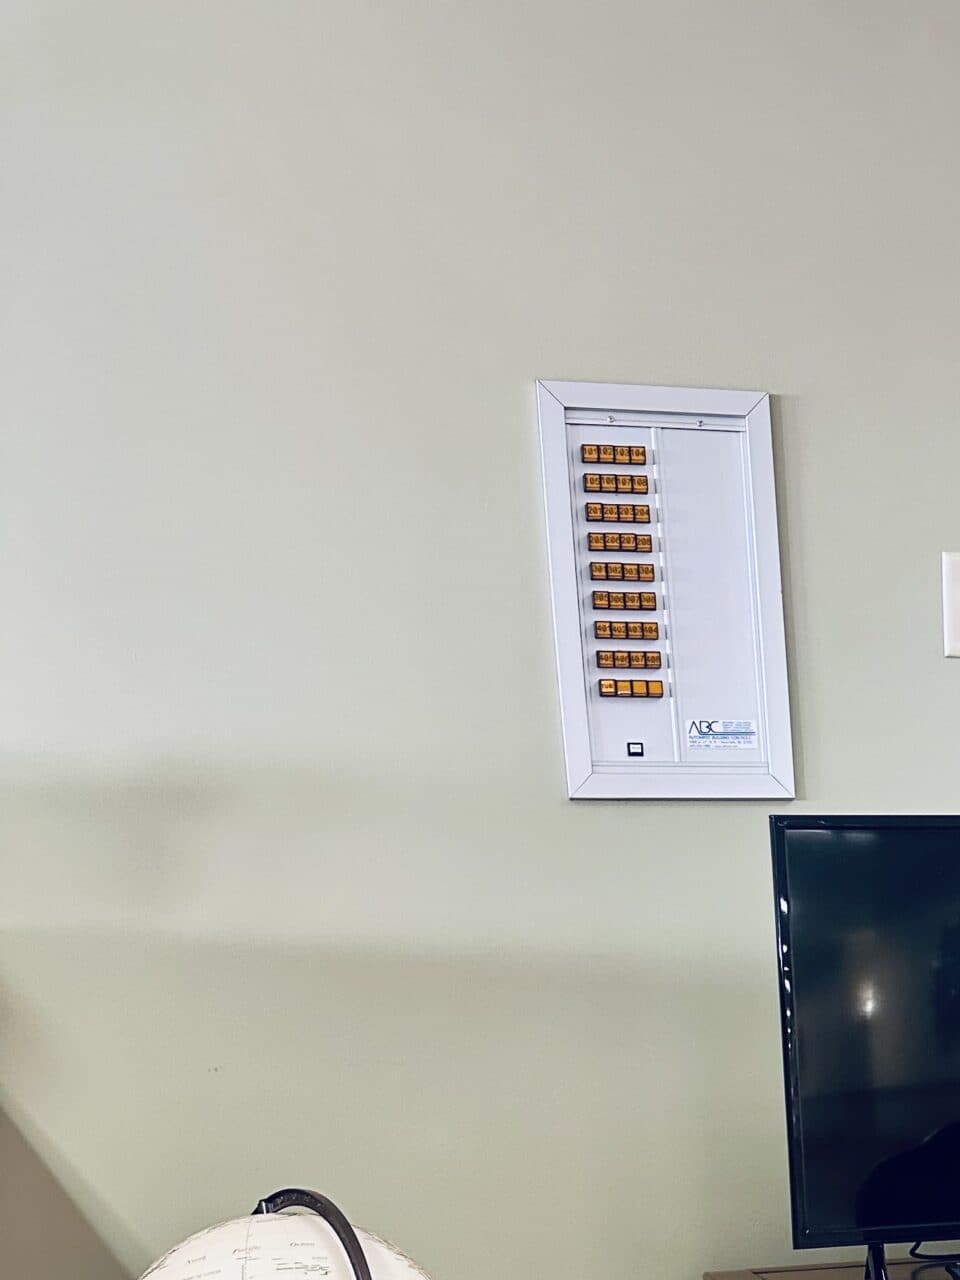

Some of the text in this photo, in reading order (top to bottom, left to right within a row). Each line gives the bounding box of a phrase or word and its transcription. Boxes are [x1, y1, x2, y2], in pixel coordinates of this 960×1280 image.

[584, 448, 598, 456] 101
[600, 448, 612, 457] 102
[632, 449, 645, 458] 104
[588, 507, 602, 515] 201
[622, 537, 636, 546] 207
[689, 720, 719, 735] ABC
